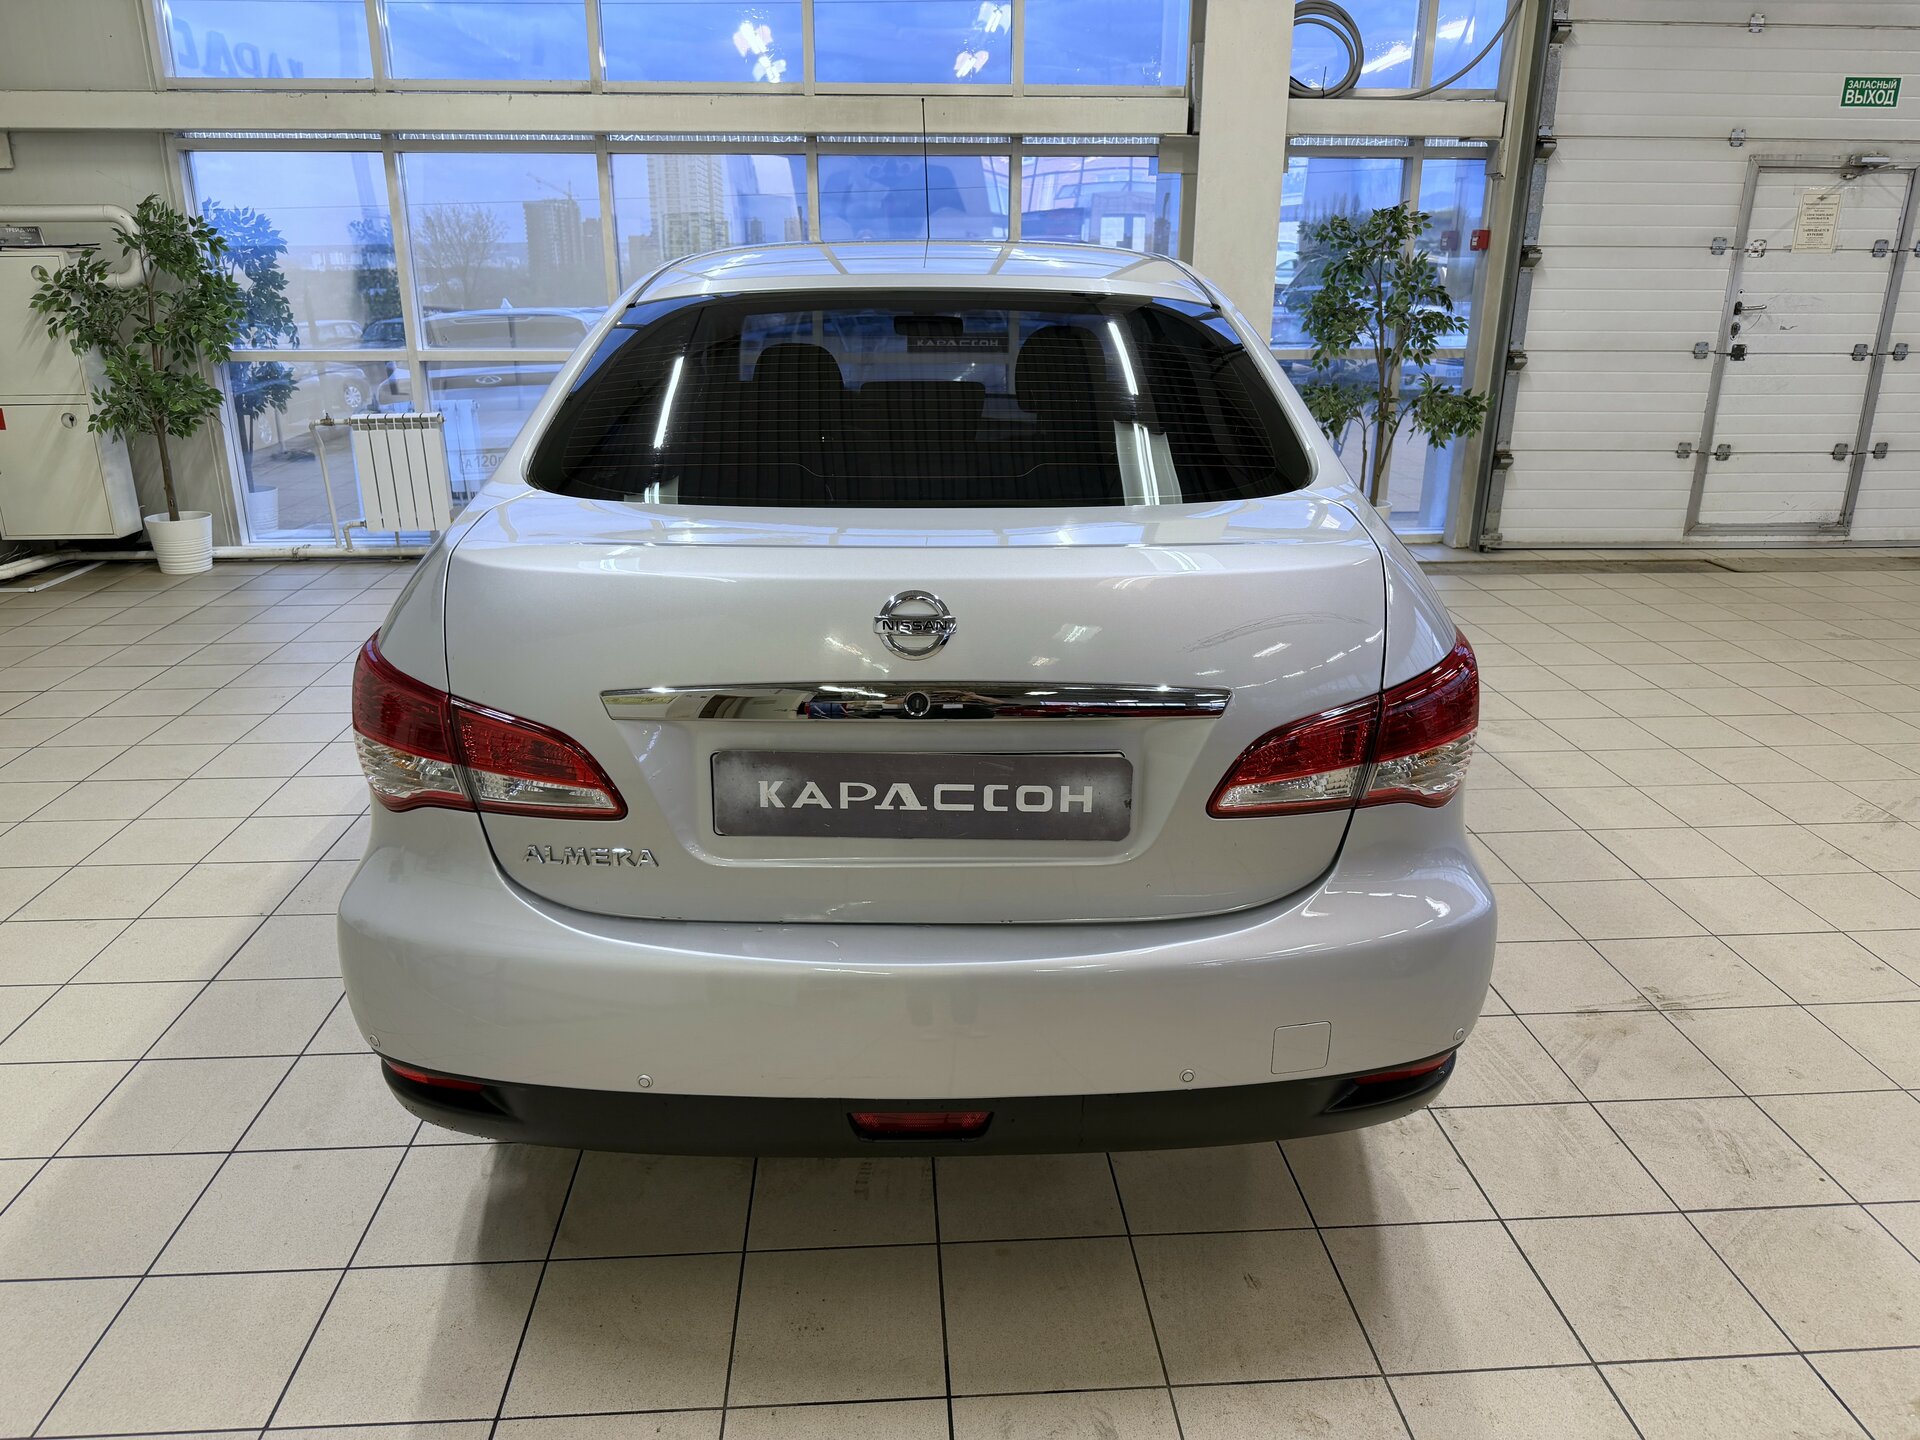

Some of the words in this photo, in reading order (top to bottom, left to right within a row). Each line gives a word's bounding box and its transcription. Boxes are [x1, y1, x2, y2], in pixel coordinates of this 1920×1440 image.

[1847, 79, 1898, 89] ЗАПАСНЫЙ
[1844, 89, 1895, 106] ВЫХОД
[882, 620, 948, 631] NISSAN
[758, 780, 1094, 813] КАРАССОН
[522, 845, 660, 867] ALMERA
